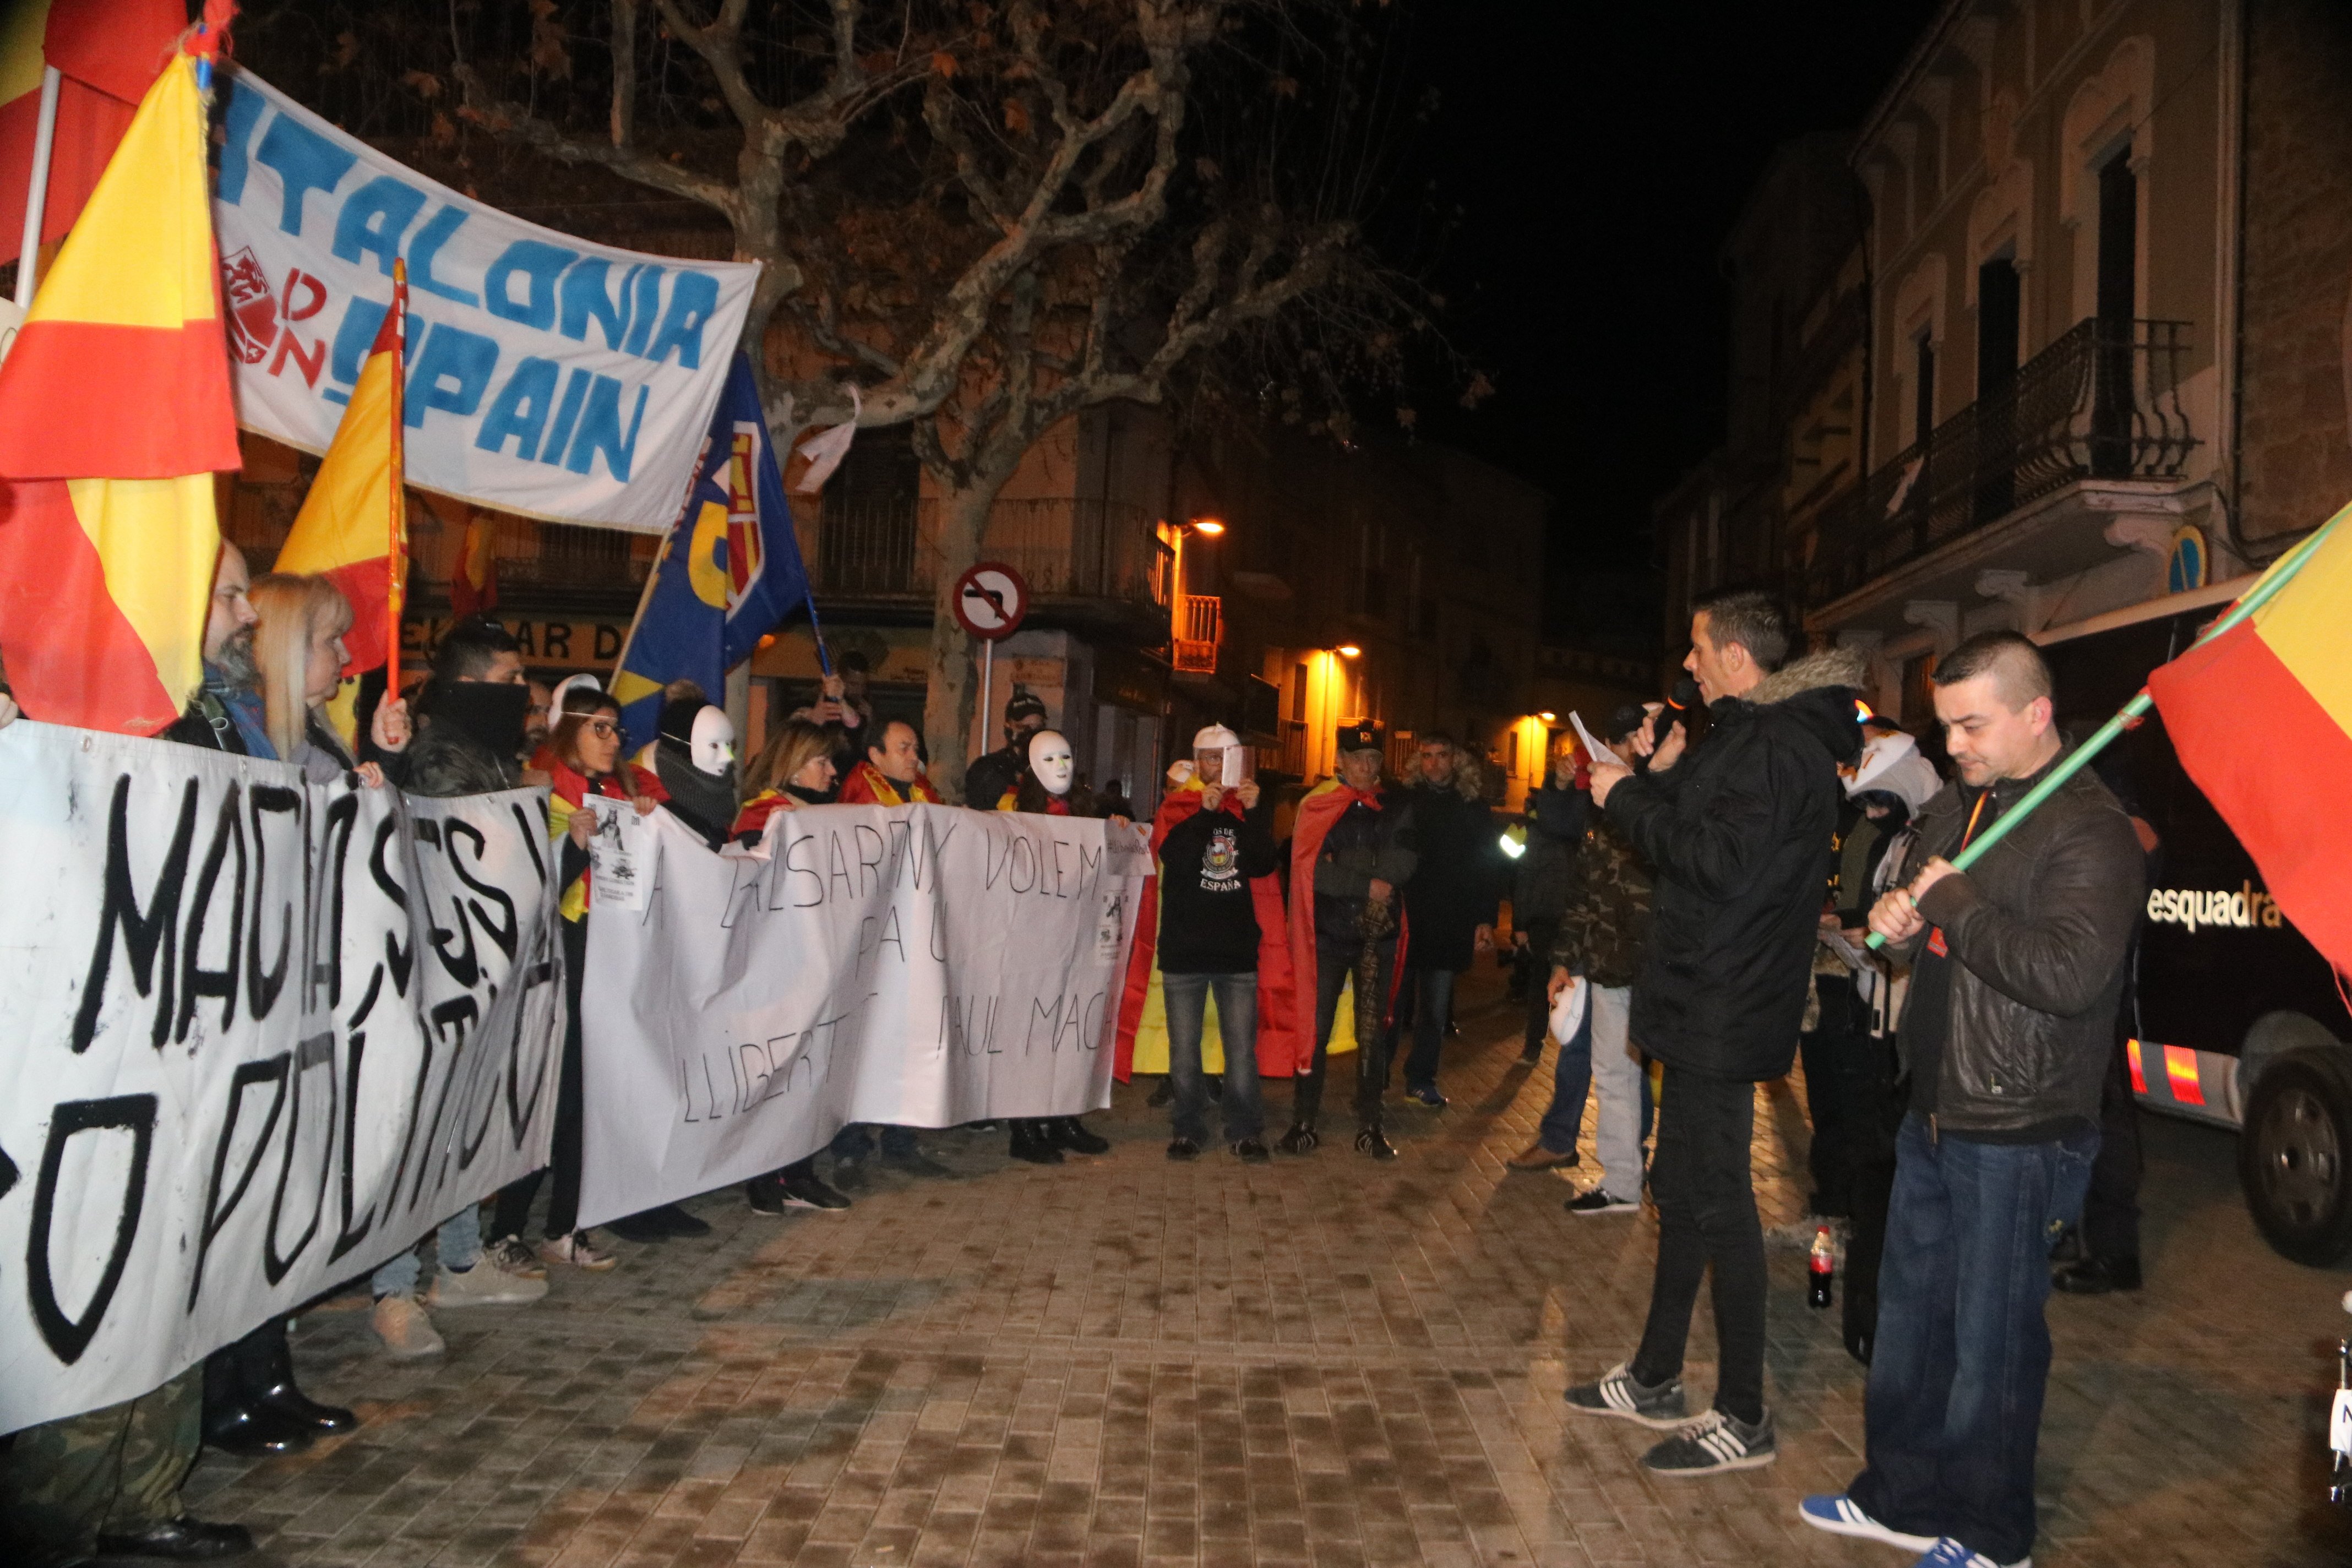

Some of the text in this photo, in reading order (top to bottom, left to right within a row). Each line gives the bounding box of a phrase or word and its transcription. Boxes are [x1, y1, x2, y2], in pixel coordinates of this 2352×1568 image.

[323, 296, 650, 483] SPAIN
[514, 620, 572, 658] AR
[986, 827, 1102, 900] VOLEM
[1200, 878, 1242, 892] ESPAÑA
[2147, 879, 2283, 933] esquadra
[855, 901, 948, 981] PAU
